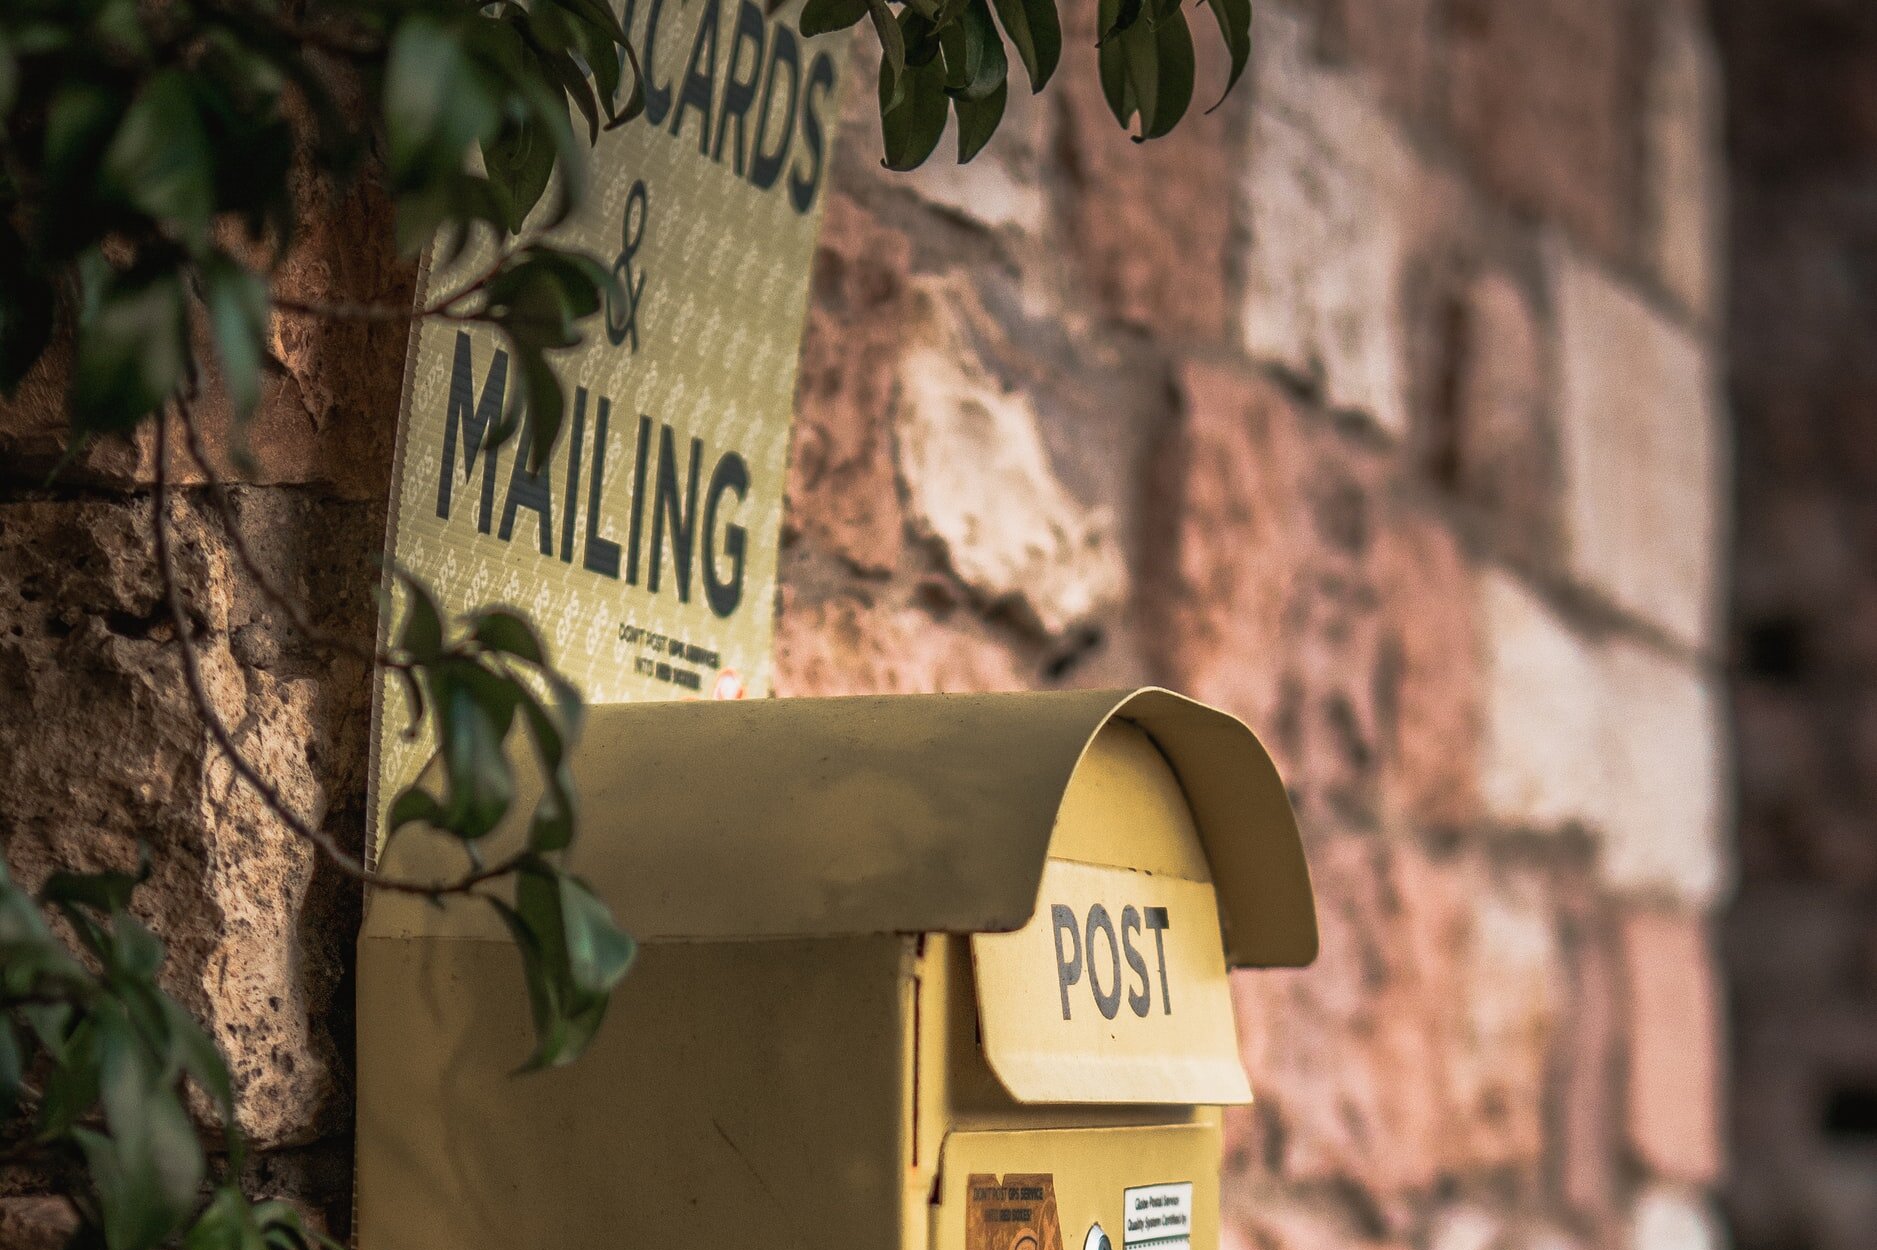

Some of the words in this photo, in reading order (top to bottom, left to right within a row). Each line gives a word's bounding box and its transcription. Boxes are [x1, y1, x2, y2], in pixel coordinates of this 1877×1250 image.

[605, 179, 648, 357] &
[436, 330, 751, 618] MAILING
[1050, 903, 1171, 1020] POST
[993, 1187, 1007, 1201] POST
[1008, 1187, 1019, 1201] GPS
[1021, 1187, 1044, 1201] SERVICE
